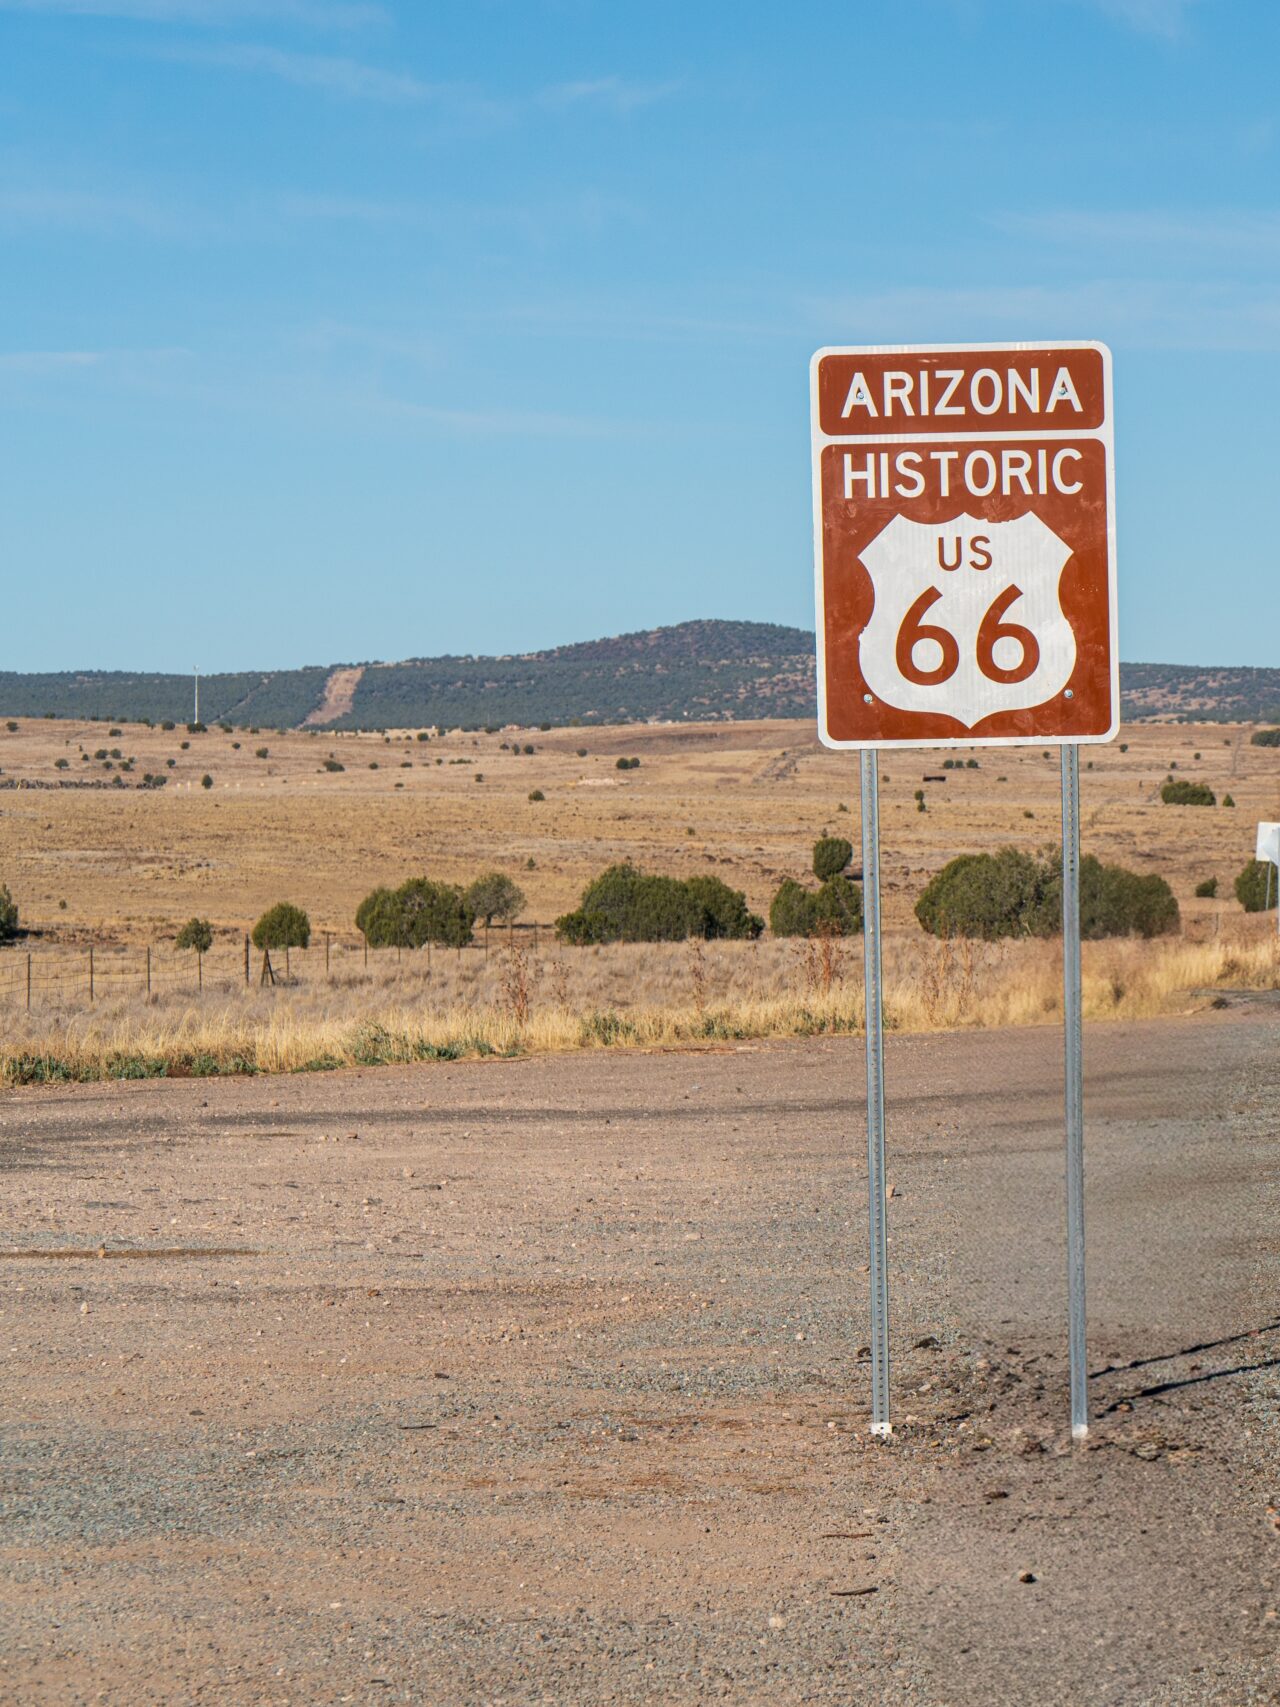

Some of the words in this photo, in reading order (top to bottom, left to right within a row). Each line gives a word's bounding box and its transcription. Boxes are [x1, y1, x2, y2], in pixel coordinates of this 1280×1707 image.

[841, 367, 1084, 418] ARIZONA
[843, 448, 1084, 499] HISTORIC
[937, 535, 993, 572] US
[895, 583, 1041, 687] 66
